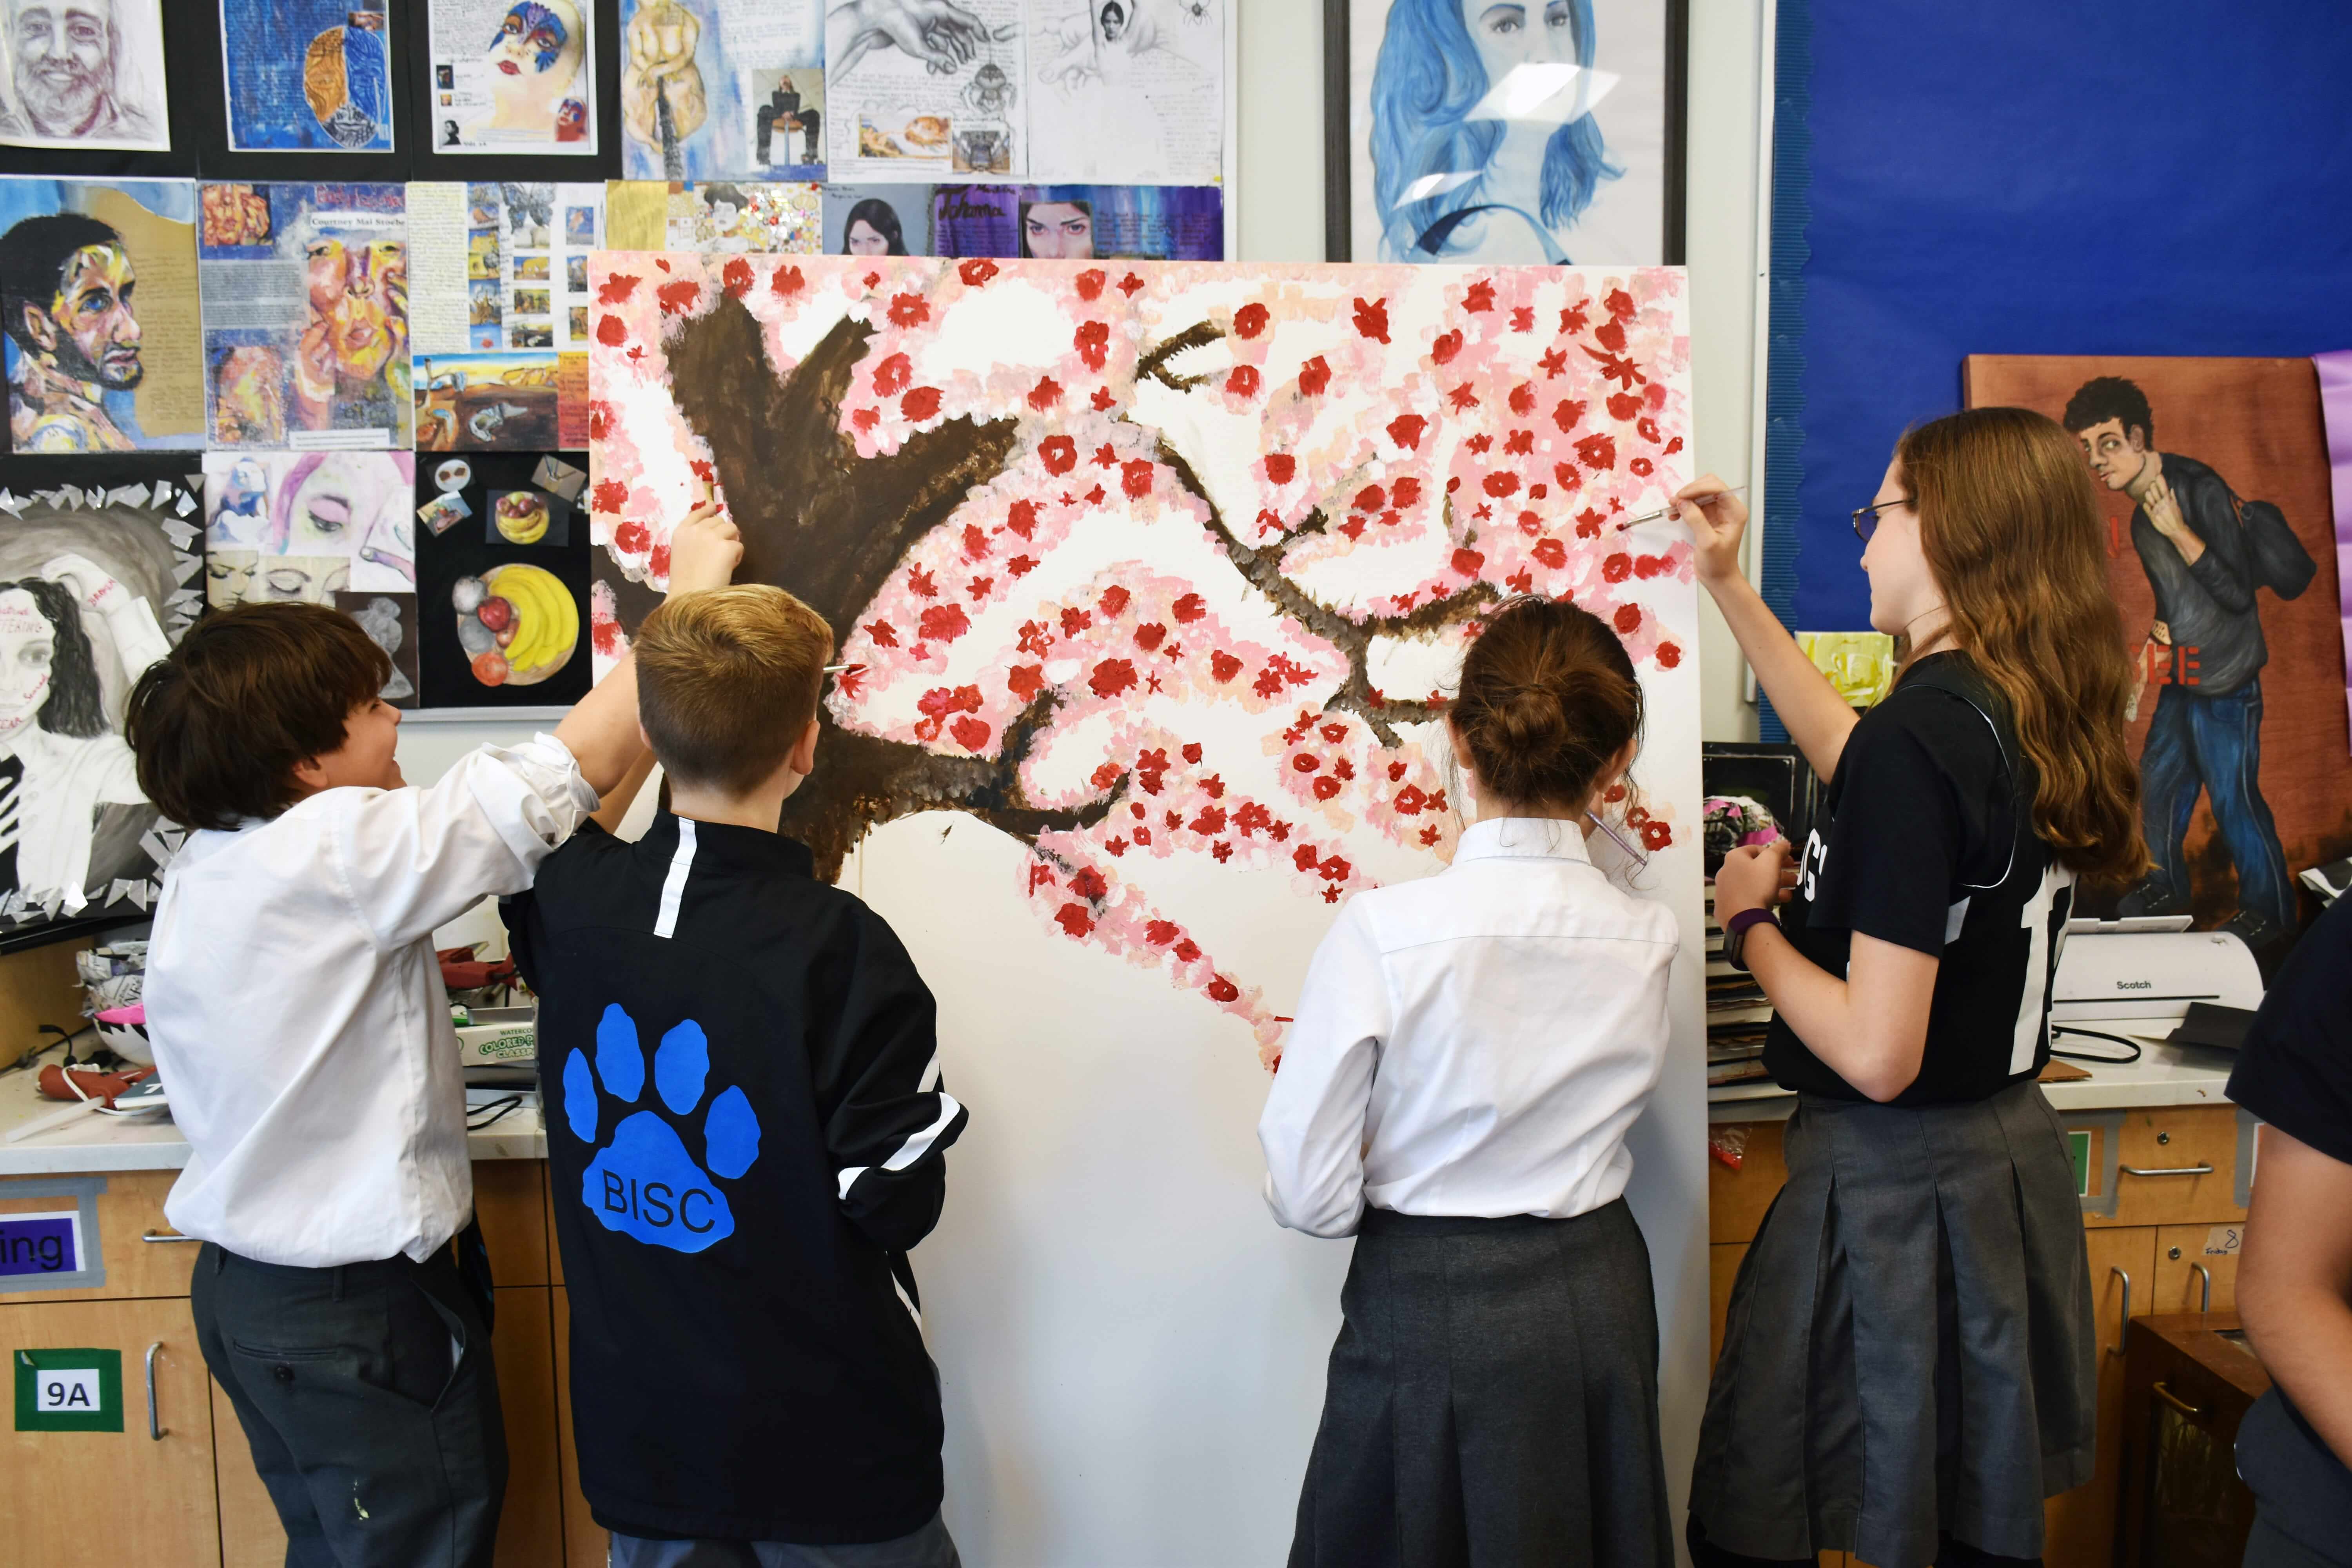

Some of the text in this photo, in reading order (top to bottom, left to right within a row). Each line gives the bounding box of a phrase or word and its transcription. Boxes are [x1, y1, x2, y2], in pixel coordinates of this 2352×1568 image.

[2116, 980, 2151, 989] Scotch
[479, 1034, 534, 1055] COLORED P
[495, 1048, 534, 1059] CLASSP
[603, 1169, 715, 1233] BISC
[0, 1229, 62, 1270] ing
[47, 1382, 90, 1406] 9A
